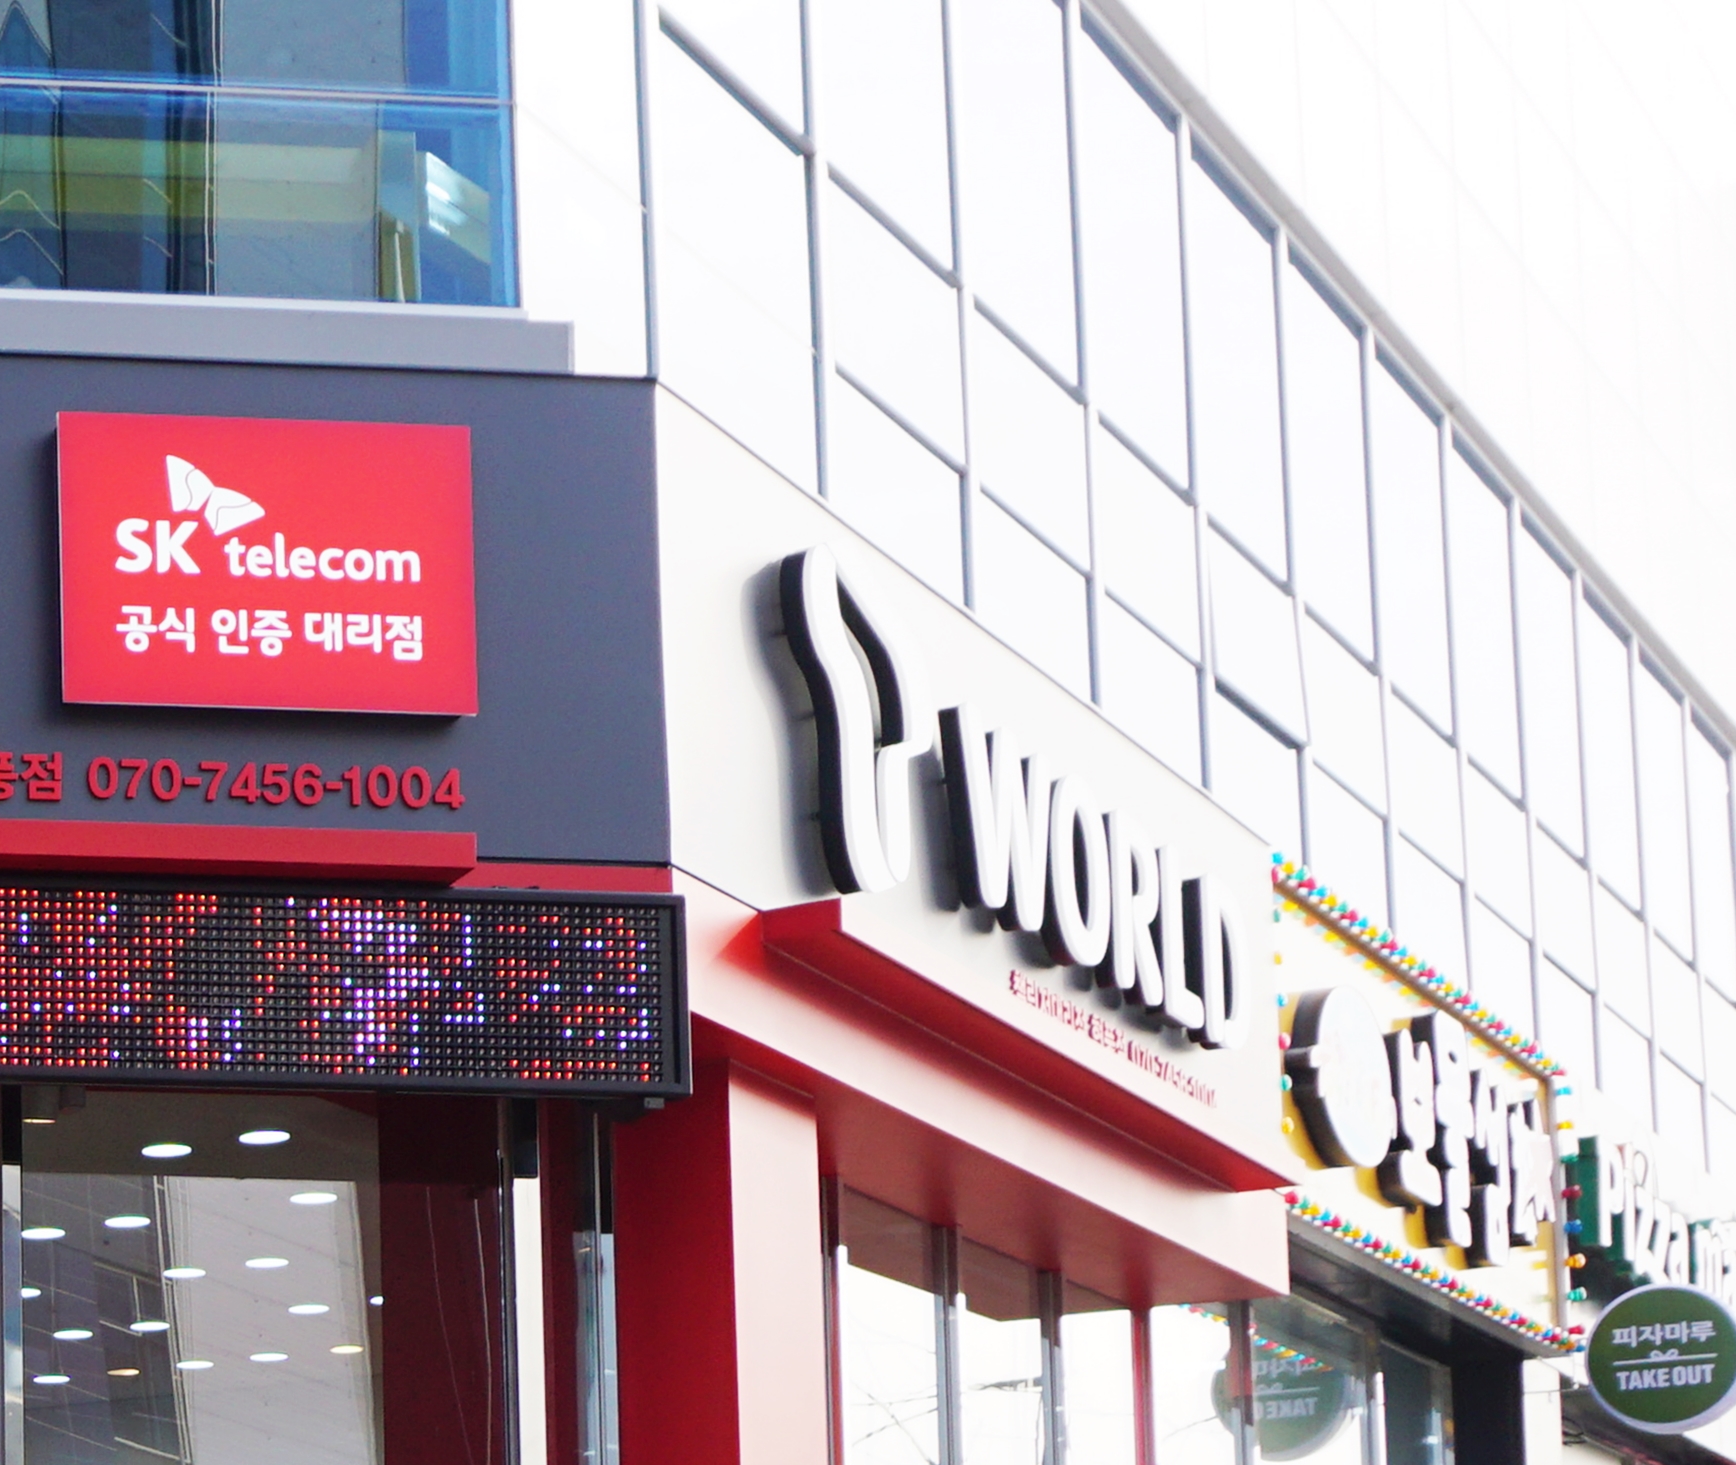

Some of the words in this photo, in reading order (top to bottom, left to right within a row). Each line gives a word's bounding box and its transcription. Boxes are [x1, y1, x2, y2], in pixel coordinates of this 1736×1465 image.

[114, 516, 202, 577] SK
[224, 532, 422, 583] telecom
[114, 604, 196, 655] 공식
[210, 607, 291, 657] 인증
[304, 609, 423, 662] 대리점
[87, 756, 466, 811] 070-7456-1004
[939, 703, 1250, 1052] WORLD
[1610, 1318, 1718, 1350] 피자마루
[1616, 1366, 1669, 1393] TAKE
[1672, 1363, 1714, 1388] OUT
